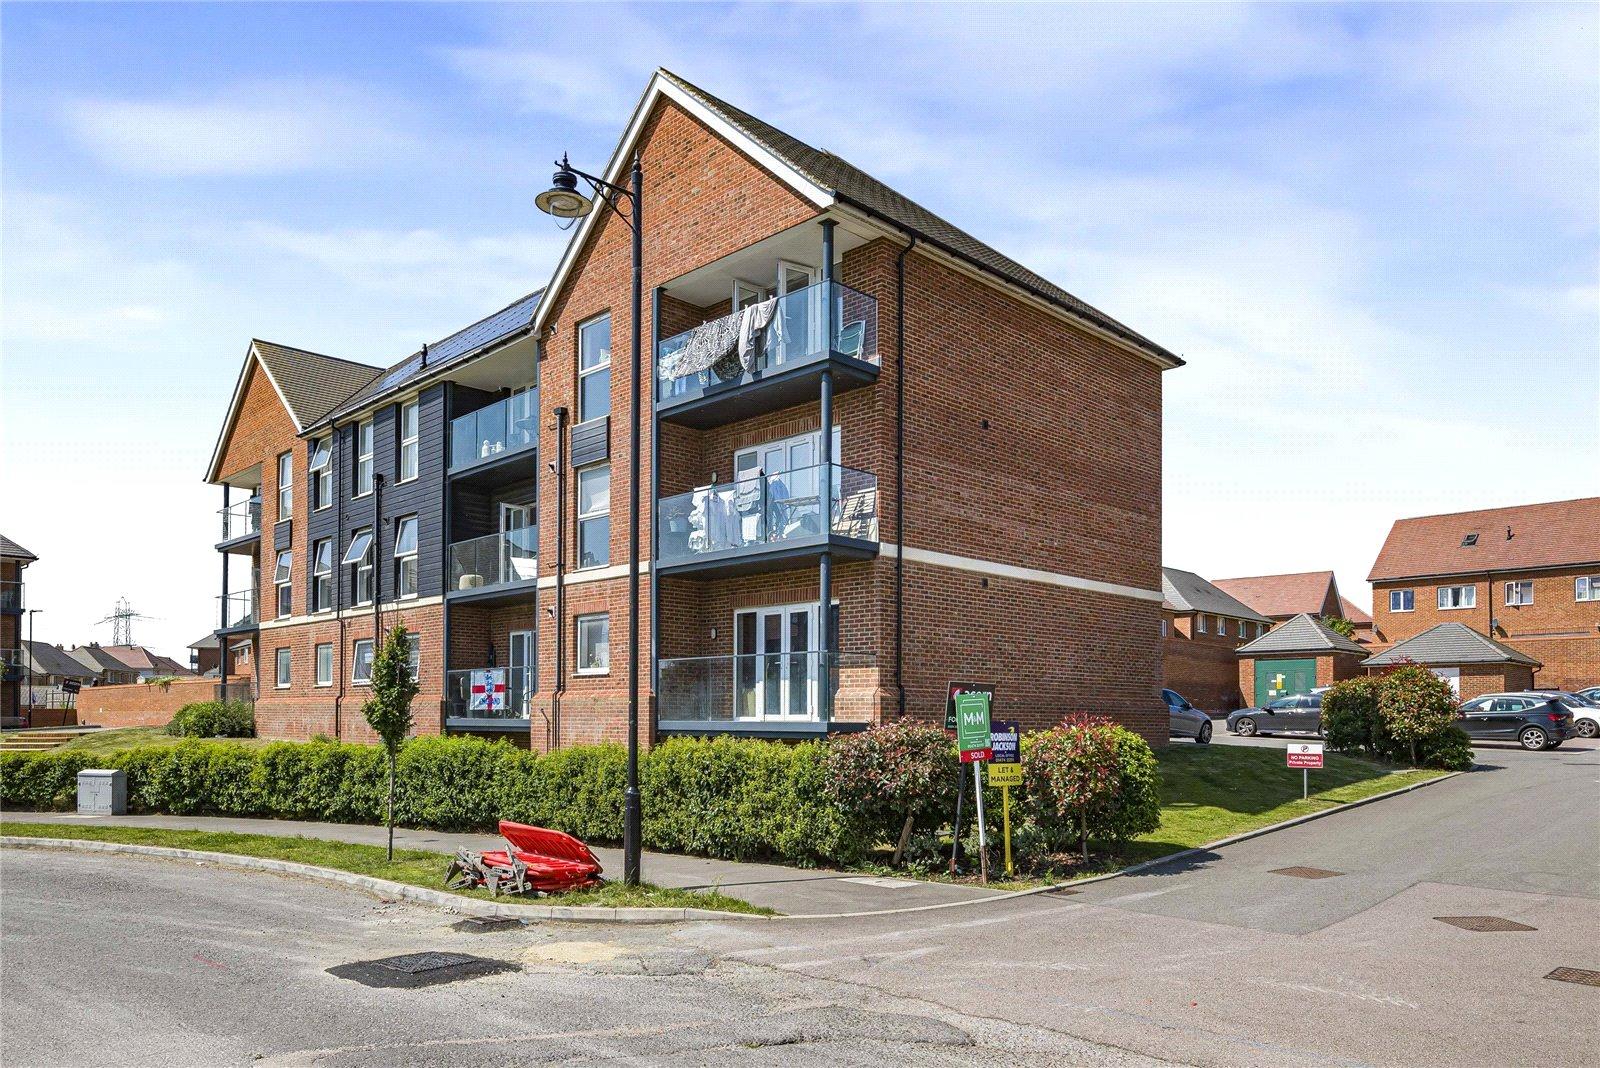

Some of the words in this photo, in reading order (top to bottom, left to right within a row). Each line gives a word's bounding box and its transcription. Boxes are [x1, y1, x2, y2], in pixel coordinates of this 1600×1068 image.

[990, 733, 1017, 741] ROBINSON
[992, 742, 1015, 750] JACKSON
[970, 751, 984, 759] SOLD
